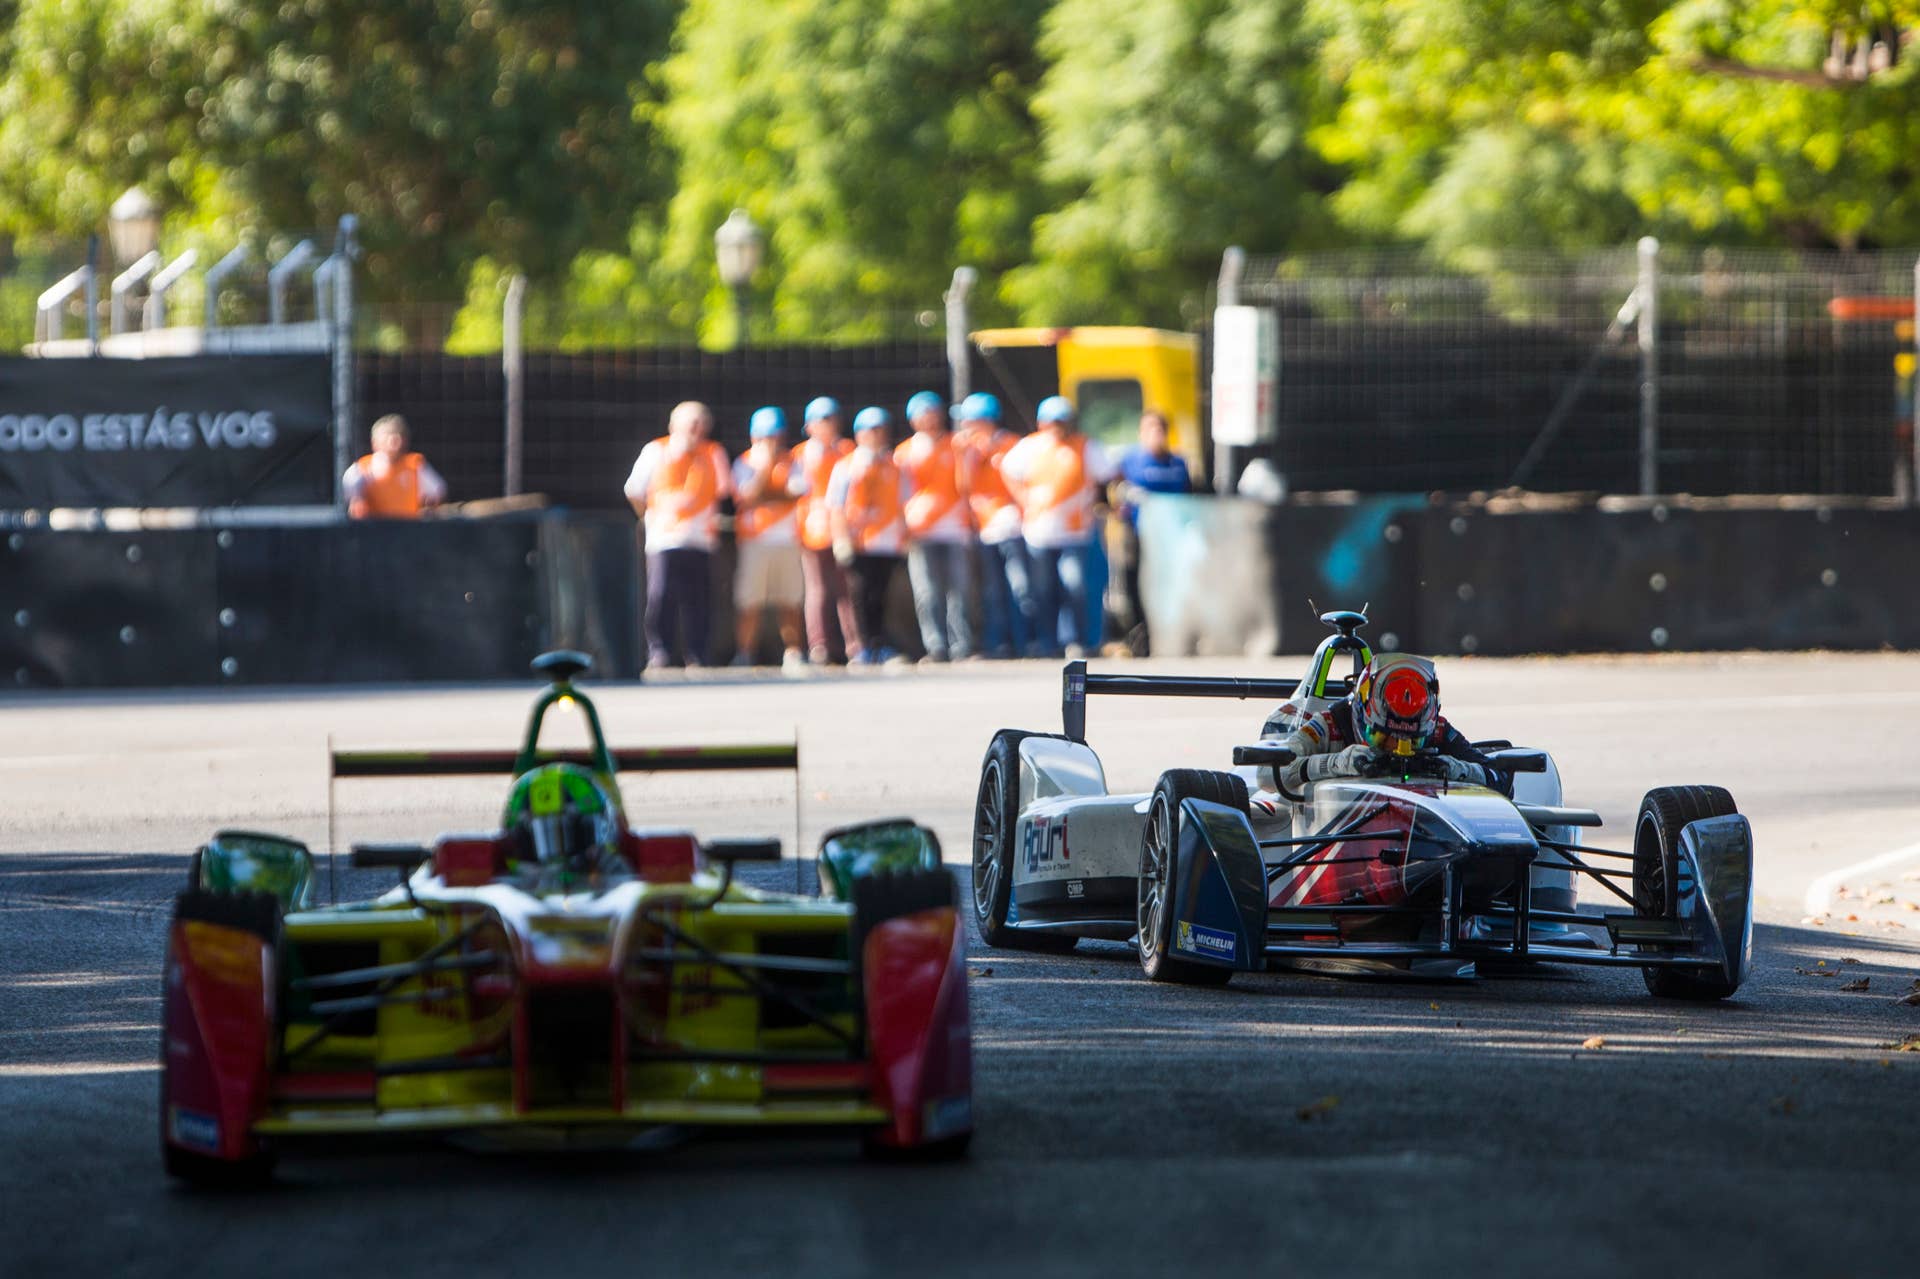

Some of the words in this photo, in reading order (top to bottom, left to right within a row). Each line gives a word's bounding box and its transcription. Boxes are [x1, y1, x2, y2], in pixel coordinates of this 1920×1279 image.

[83, 405, 196, 450] ESTÁS
[198, 410, 276, 448] VOS
[1196, 933, 1234, 950] MICHELIN
